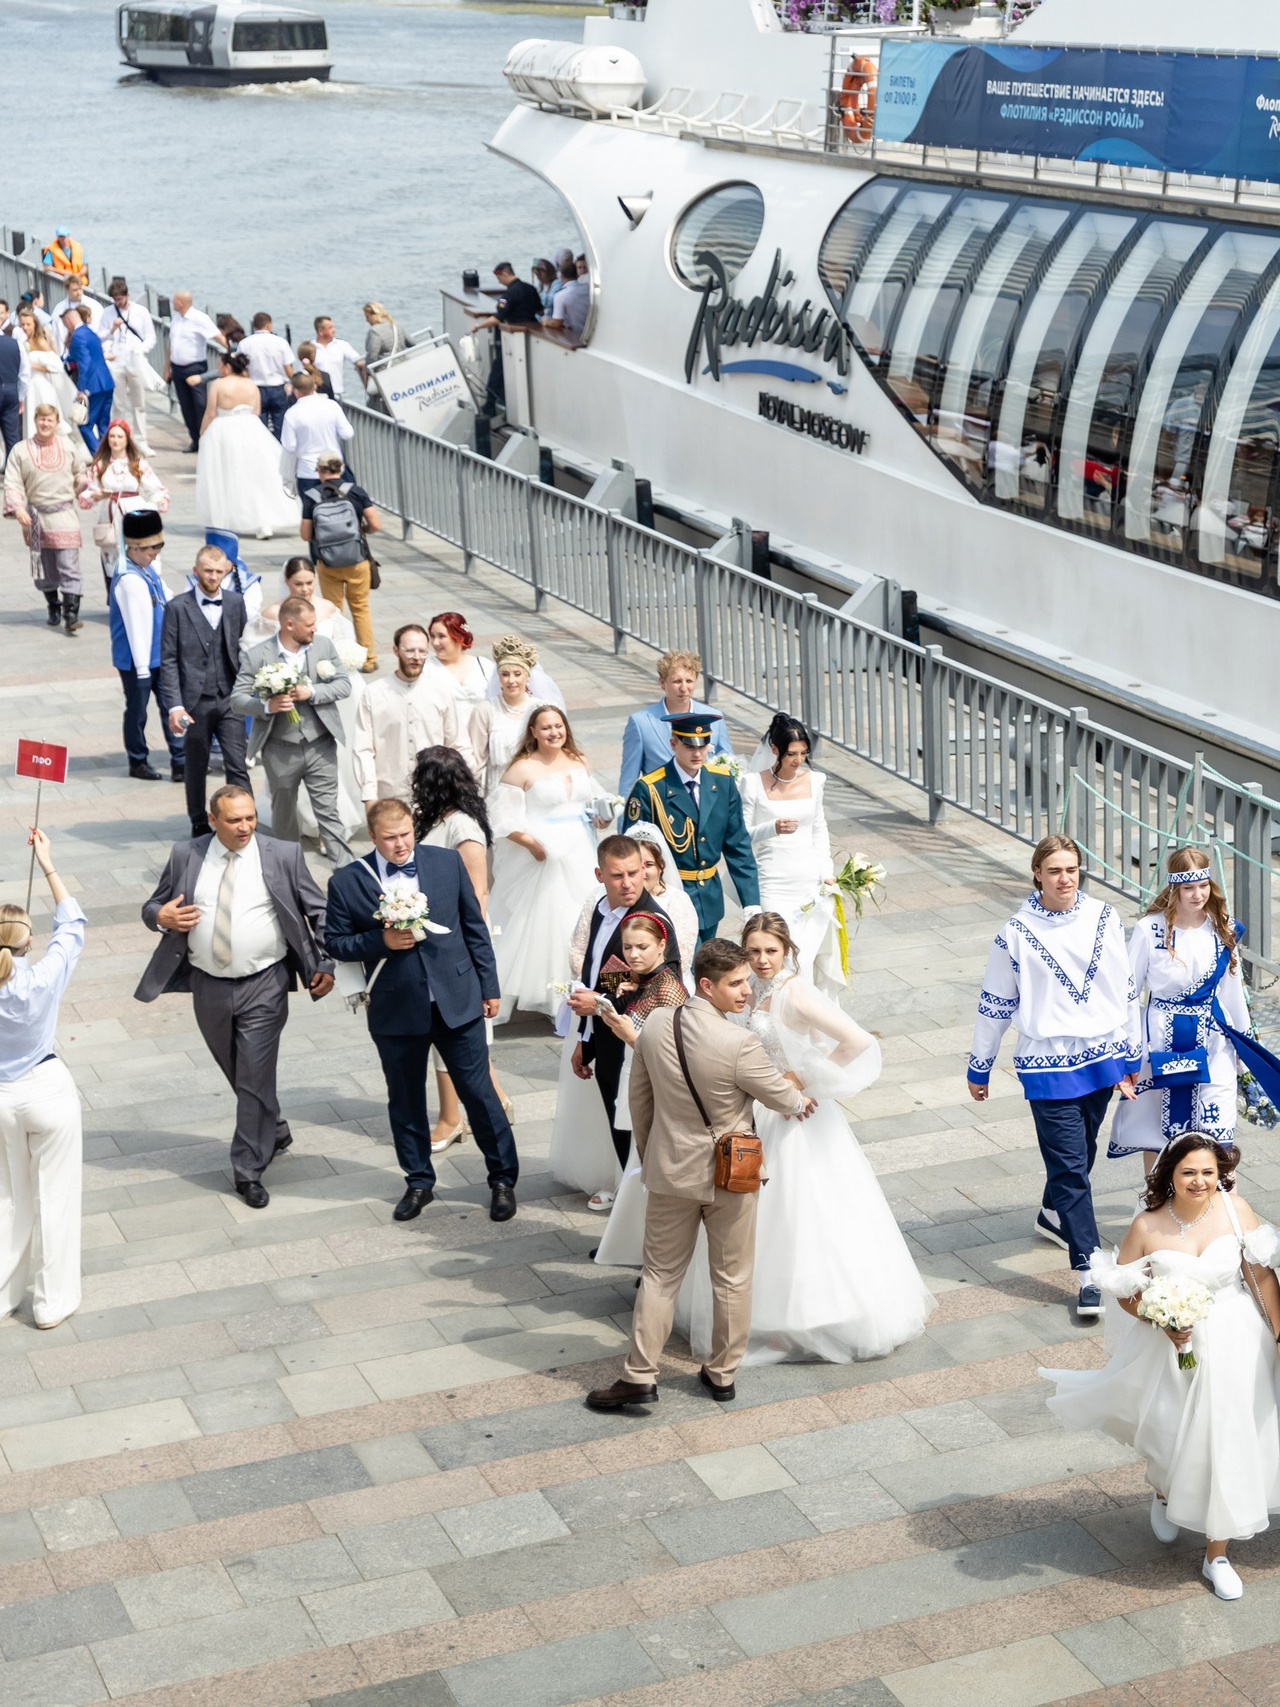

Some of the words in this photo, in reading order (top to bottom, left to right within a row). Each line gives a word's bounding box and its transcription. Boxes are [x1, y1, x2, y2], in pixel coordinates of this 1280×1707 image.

[986, 80, 1011, 96] ВАШЕ
[1011, 81, 1072, 100] ПУТЕШЕСТВИЕ
[1072, 85, 1130, 104] НАЧИНАЕТСЯ
[1131, 89, 1164, 109] ЗДЕСЬ!
[1000, 103, 1048, 122] ФЛОТИЛИЯ
[1048, 107, 1103, 127] «РЭДИССОН
[1104, 107, 1144, 129] РОЙАЛ»
[685, 247, 848, 384] Radisson
[758, 391, 804, 432] ROYAL
[800, 408, 866, 455] MOSCOW
[32, 755, 52, 766] ПФО
